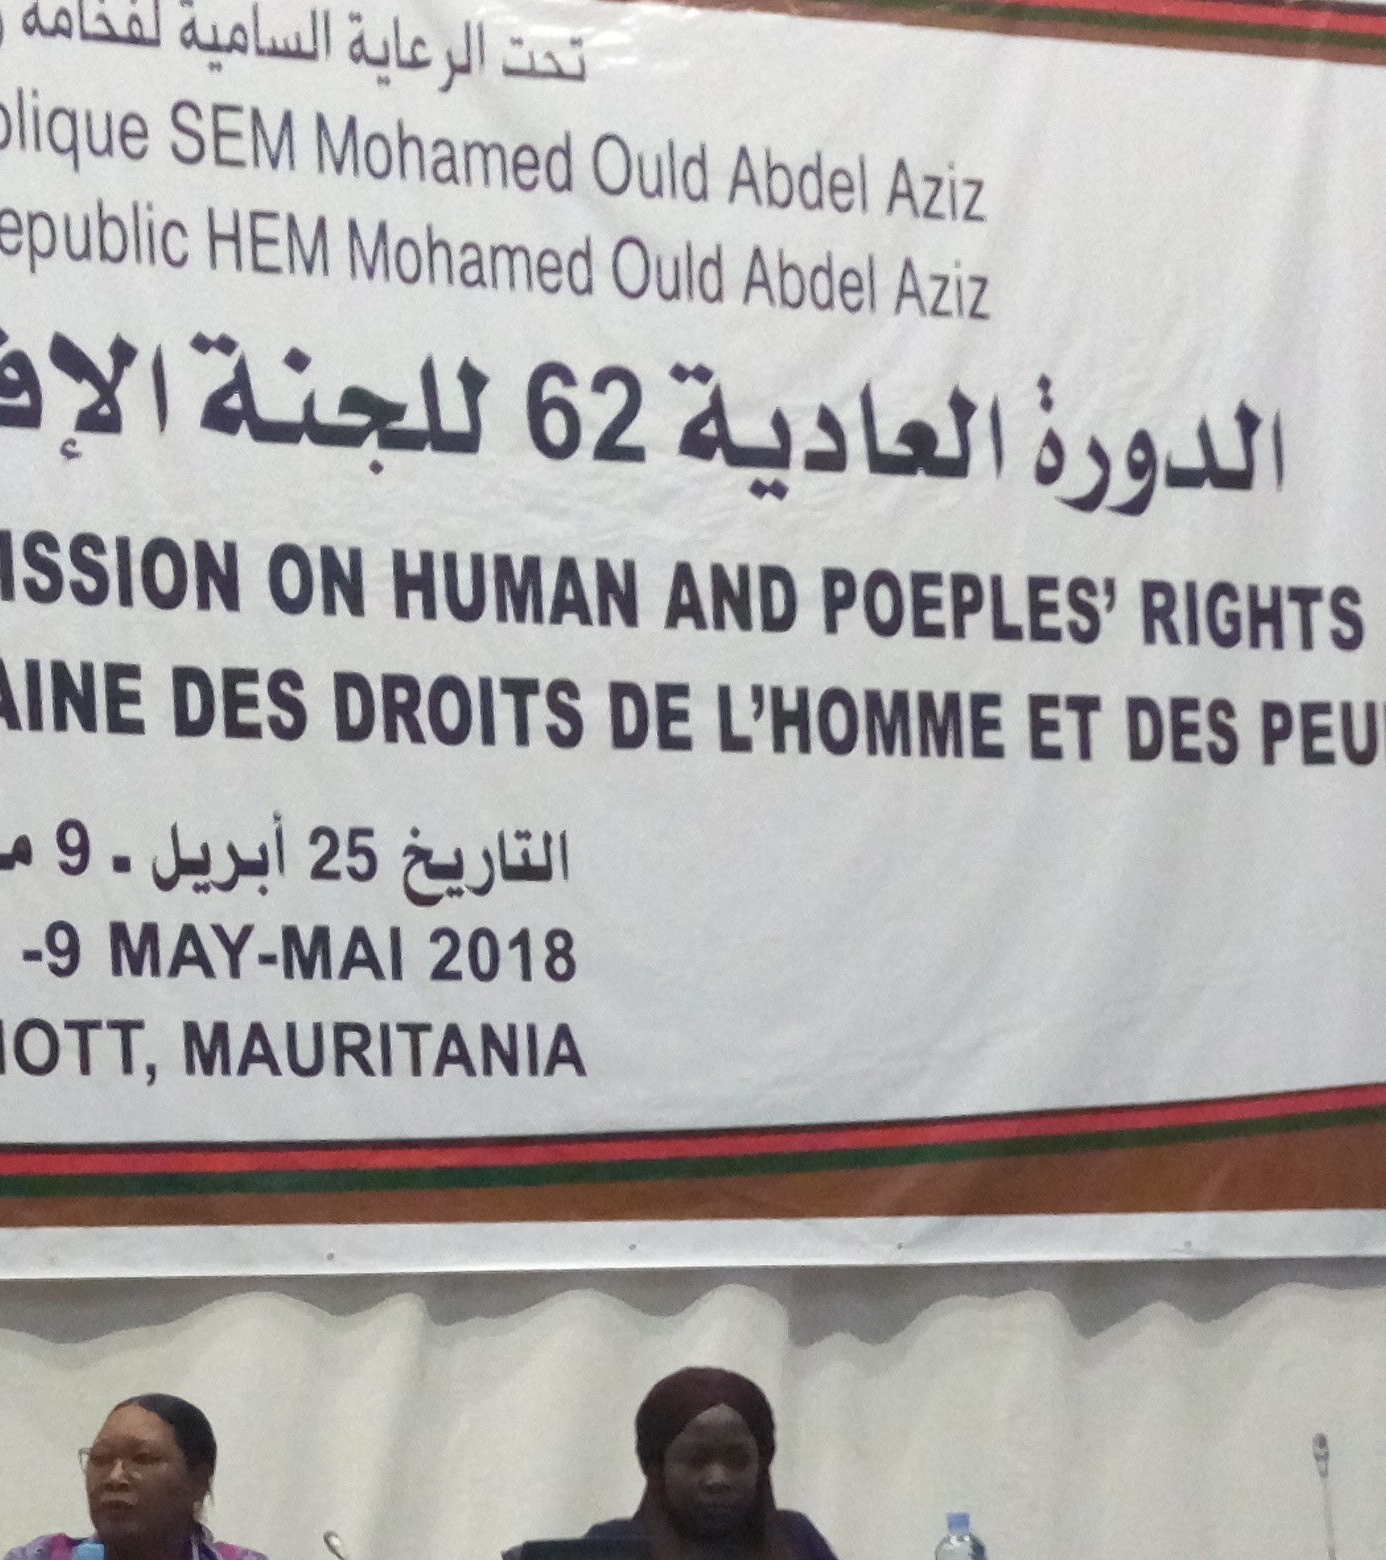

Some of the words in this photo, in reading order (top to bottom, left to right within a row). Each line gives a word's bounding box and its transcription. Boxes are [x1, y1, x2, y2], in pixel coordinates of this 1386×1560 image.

[349, 13, 484, 93] الرعاية
[502, 37, 586, 82] تحت
[171, 100, 294, 170] SEM
[316, 112, 572, 193] Mohamed
[593, 133, 707, 202] Ould
[729, 146, 866, 213] Abdel
[887, 158, 984, 221] Aziz
[208, 207, 328, 276] HEM
[348, 218, 592, 296] Mohamed
[612, 236, 723, 303] Ould
[743, 246, 875, 313] Abdel
[895, 258, 989, 320] Aziz
[190, 332, 489, 474] للجنة
[527, 361, 645, 463] 62
[669, 363, 1003, 501] العادية
[1035, 374, 1284, 517] الدورة
[268, 543, 365, 617] ON
[393, 549, 638, 628] HUMAN
[664, 561, 798, 633] AND
[1141, 580, 1364, 652] RIGHTS
[172, 666, 307, 741] DES
[334, 672, 584, 749] DROITS
[609, 681, 693, 751] DE
[1028, 693, 1101, 761] ET
[1126, 696, 1239, 765] DES
[56, 819, 90, 876] 9
[152, 811, 284, 896] أبريل
[309, 826, 378, 882] 25
[403, 827, 568, 907] التاريخ
[109, 921, 402, 981] MAY-MAI
[430, 927, 576, 982] 2018
[183, 1021, 587, 1077] MAURITANIA
